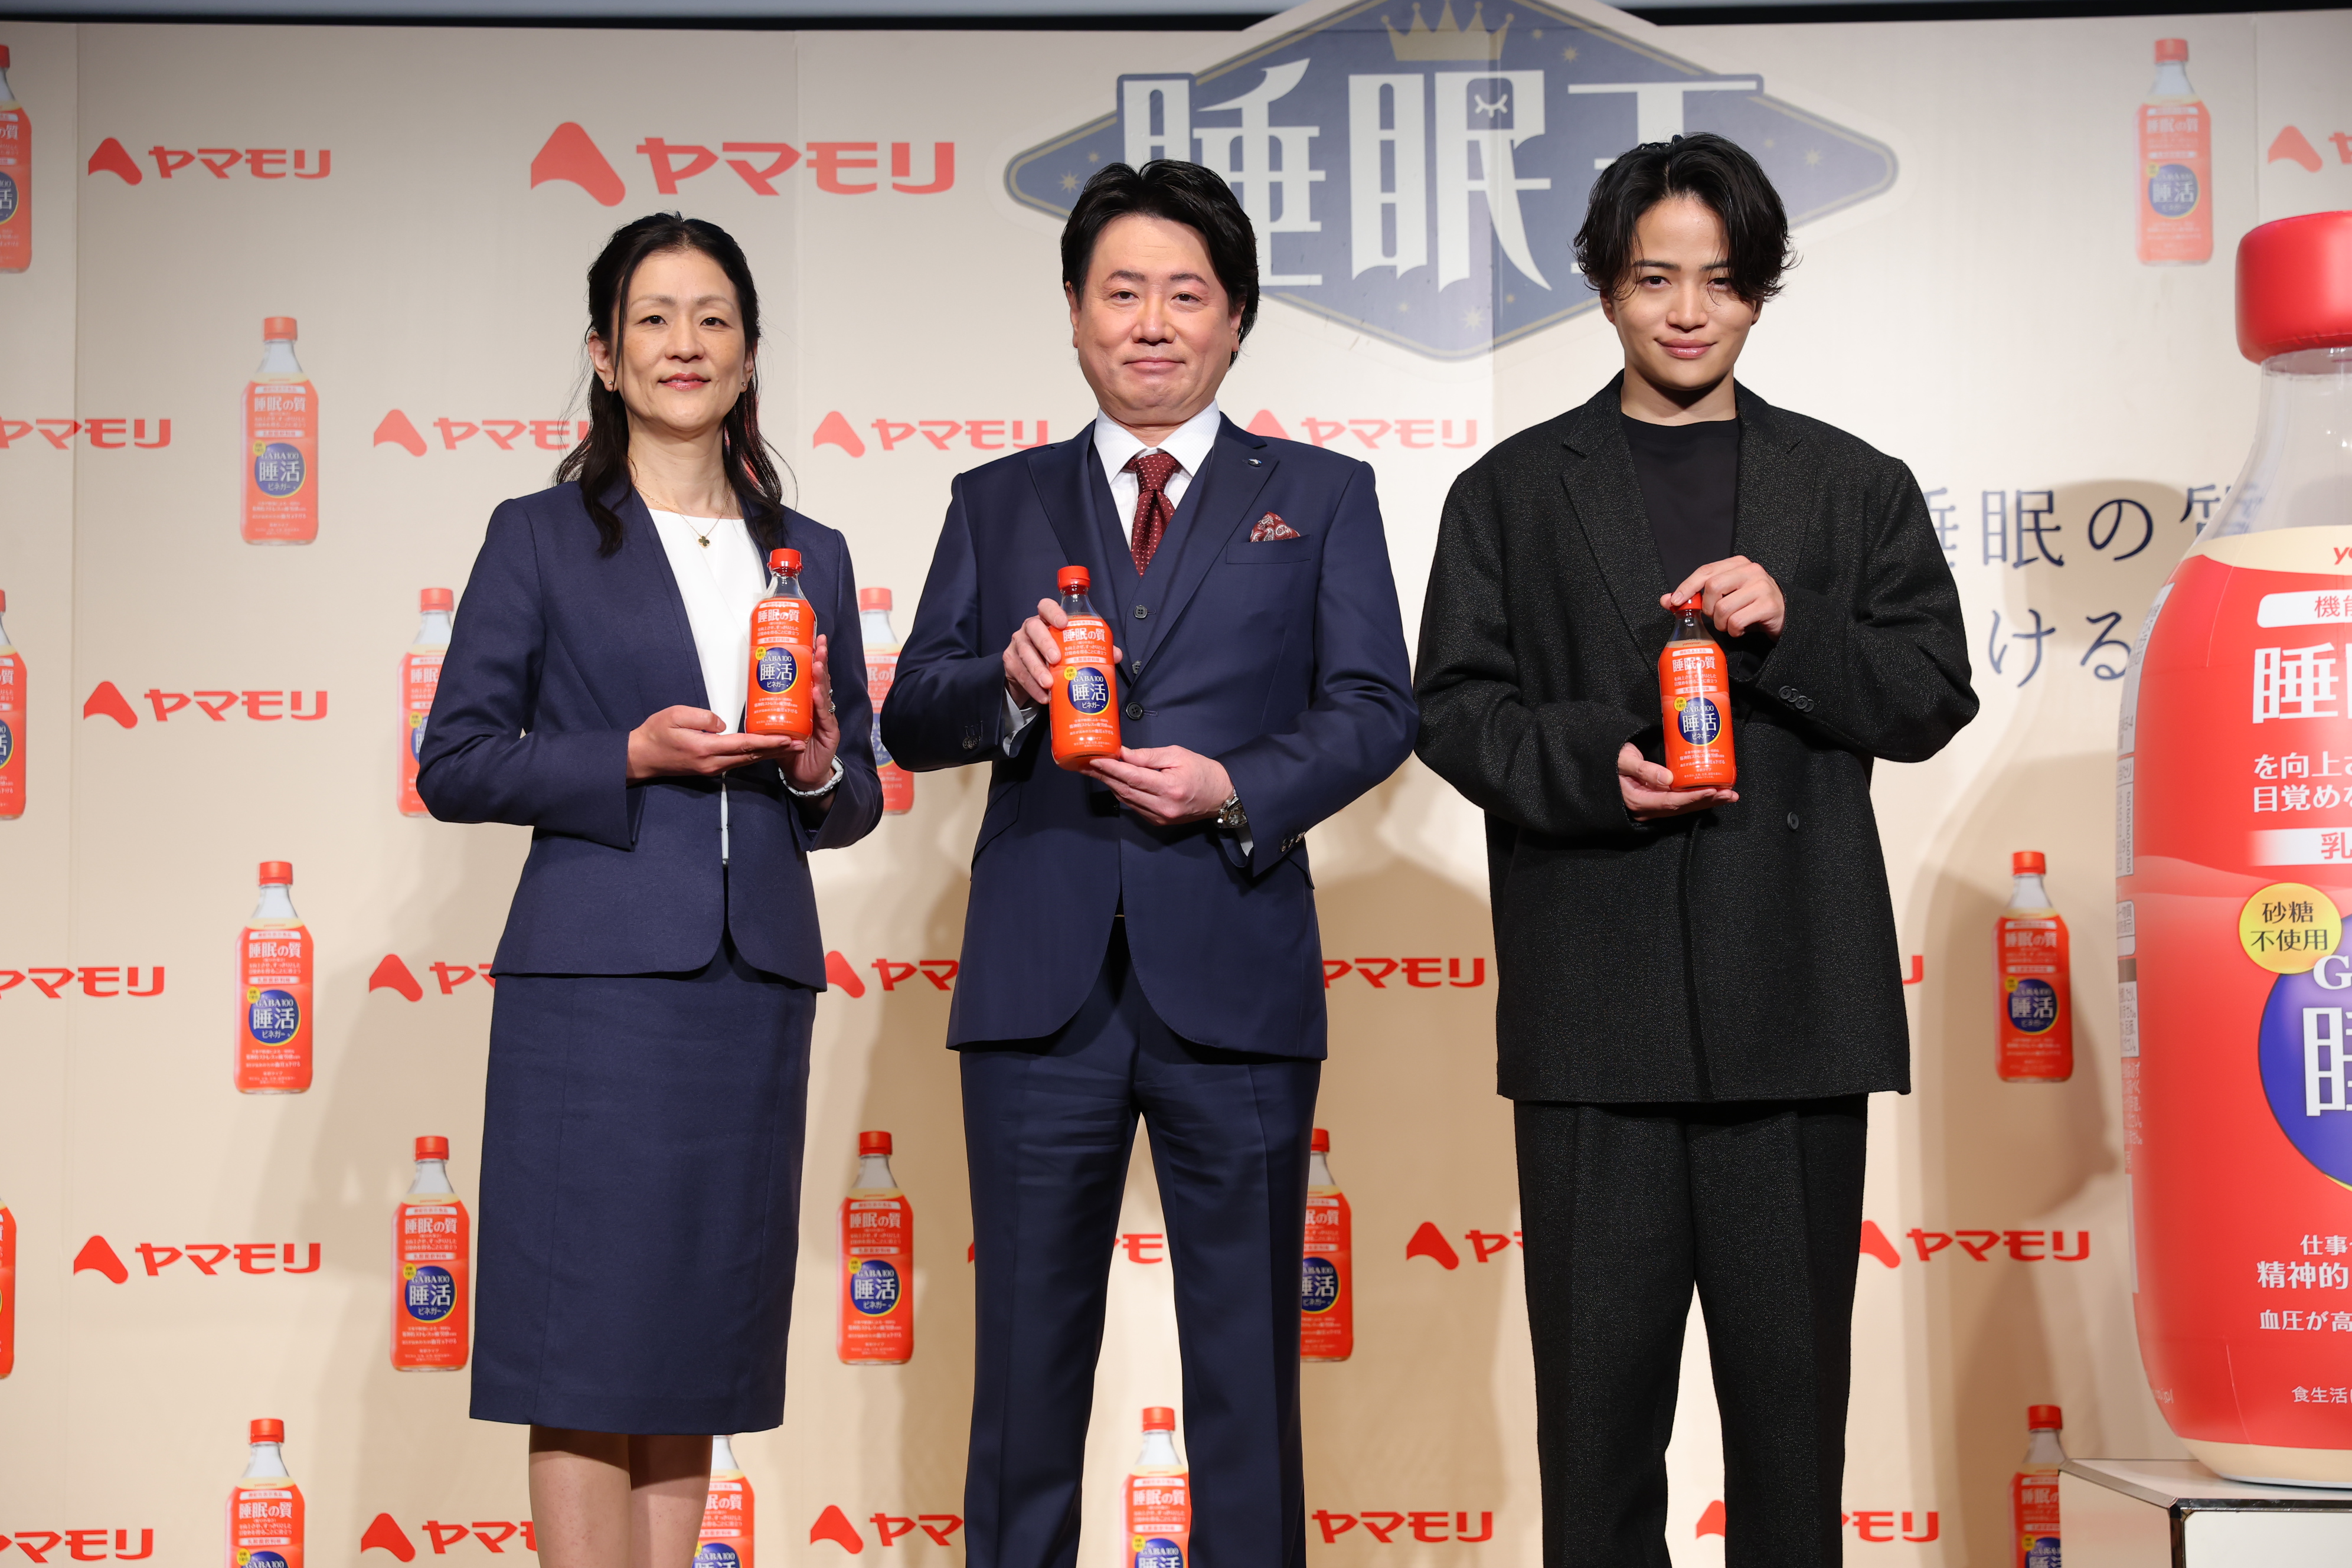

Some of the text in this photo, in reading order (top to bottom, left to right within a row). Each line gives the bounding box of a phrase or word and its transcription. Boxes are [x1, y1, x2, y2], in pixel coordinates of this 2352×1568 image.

[149, 146, 331, 179] ヤマモリ
[636, 138, 955, 196] ヤマモリ
[254, 396, 306, 413] 睡眠の質
[871, 419, 1048, 450] ヤマモリ
[1301, 417, 1477, 449] ヤマモリ
[259, 460, 300, 482] 睡活
[757, 609, 800, 623] 睡眠の質
[1063, 627, 1106, 642] 睡眠の質
[760, 662, 793, 681] 睡活
[1672, 656, 1716, 672] 睡眠の質
[1072, 682, 1106, 702] 睡活
[2252, 642, 2352, 724] 睡
[145, 689, 328, 721] ヤマモリ
[1682, 713, 1717, 733] 睡活
[2262, 900, 2314, 925] 砂糖
[249, 942, 301, 959] 睡眠の質
[2249, 929, 2328, 952] 不使用
[253, 1007, 295, 1030] 睡活
[2011, 996, 2054, 1019] 睡活
[405, 1217, 458, 1234] 睡眠の質
[850, 1213, 901, 1229] 睡眠の質
[1906, 1228, 2090, 1262] ヤマモリ
[2300, 1234, 2352, 1256] 仕事
[136, 1243, 321, 1276] ヤマモリ
[409, 1284, 452, 1306] 睡活
[854, 1278, 896, 1301] 睡活
[2291, 1385, 2352, 1404] 食生活
[1132, 1488, 1186, 1507] 睡眠の質
[239, 1501, 293, 1520] 睡眠の質
[870, 1513, 964, 1547] ヤマ
[1312, 1510, 1493, 1544] ヤマモリ
[1842, 1511, 1939, 1543] モリ
[0, 1528, 153, 1563] マモリ
